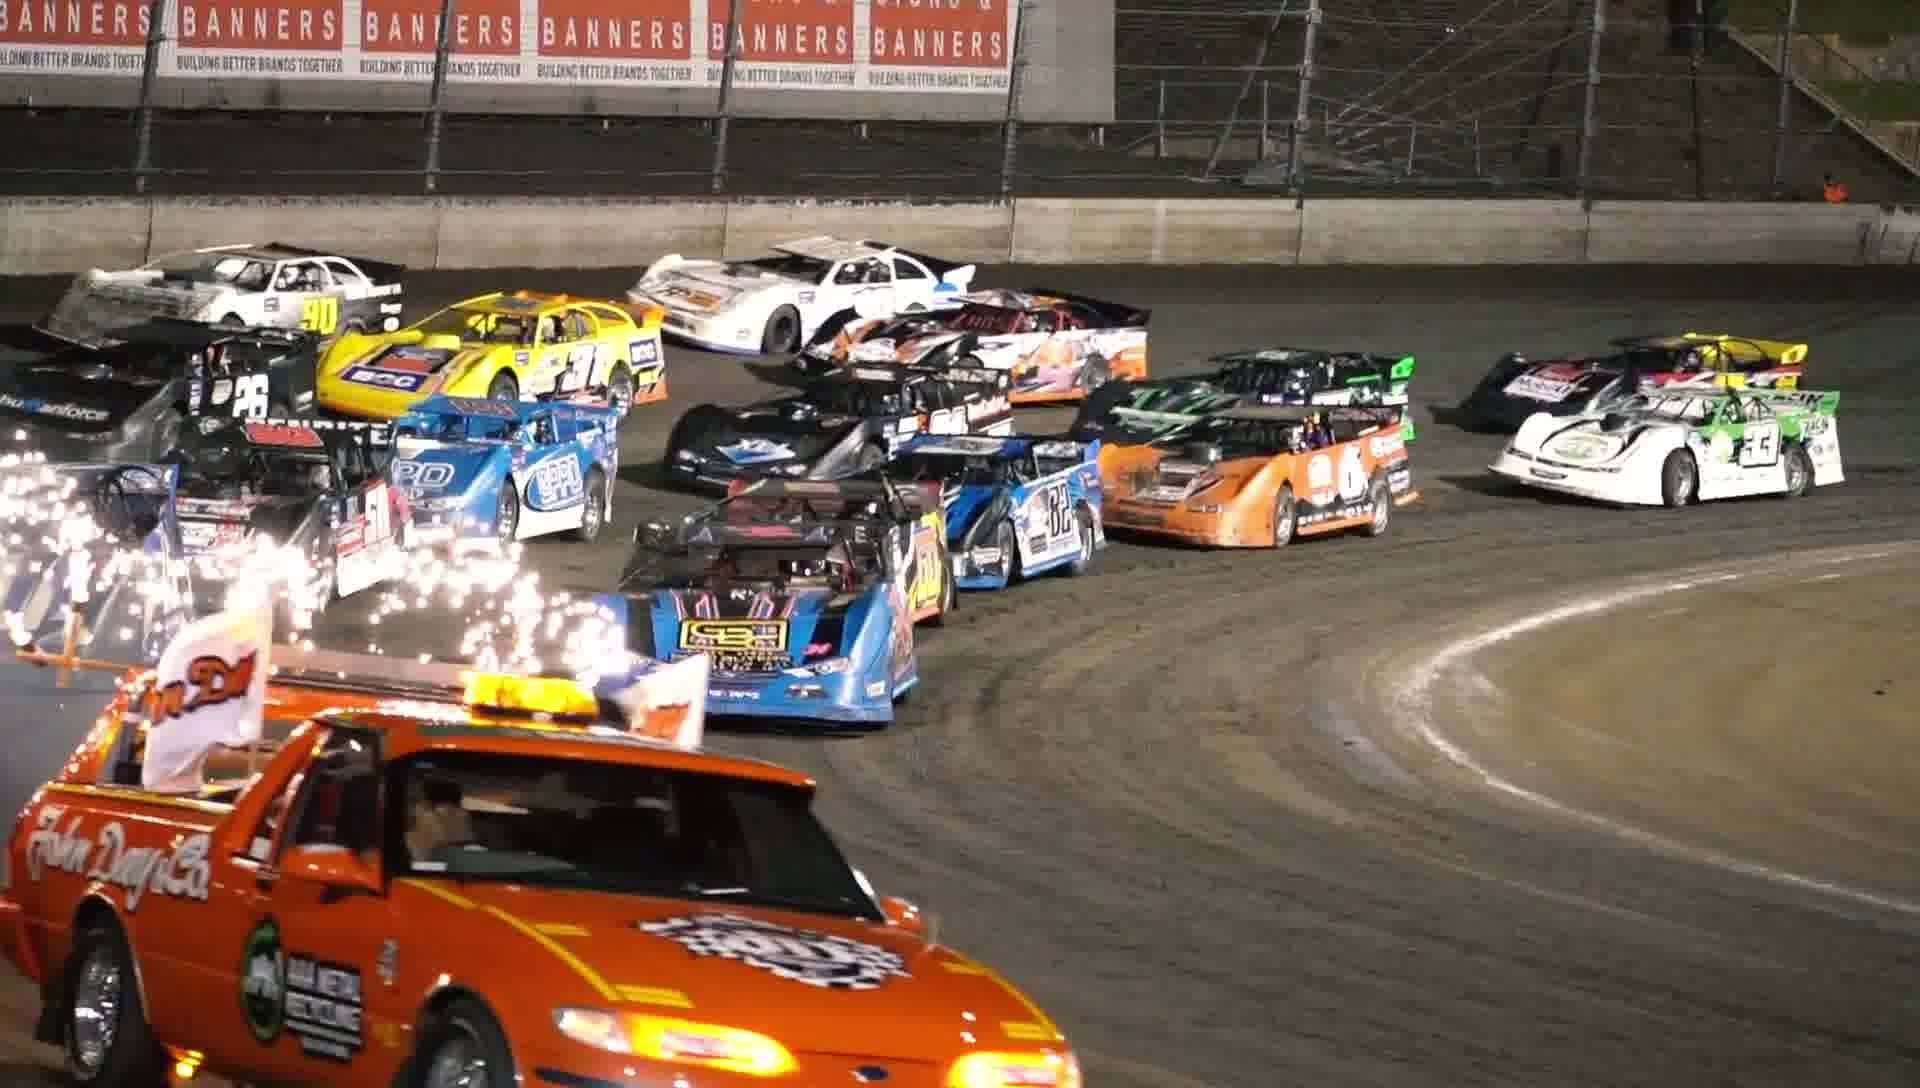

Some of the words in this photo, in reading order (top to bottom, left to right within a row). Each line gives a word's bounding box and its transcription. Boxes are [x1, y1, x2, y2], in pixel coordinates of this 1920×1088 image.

[0, 2, 149, 36] BANNERS
[183, 6, 335, 41] BANNERS
[543, 17, 683, 49] BANNERS
[712, 23, 848, 56] BANNERS
[874, 27, 1001, 60] BANNERS
[176, 55, 220, 71] BUILDING
[223, 56, 256, 71] BETTER
[258, 57, 296, 72] BRANDS
[299, 57, 343, 73] TOGETHER
[360, 59, 401, 74] BUILDING
[537, 63, 578, 79] BUILDING
[305, 294, 338, 334] 90
[232, 374, 268, 418] 26
[26, 806, 92, 880] John
